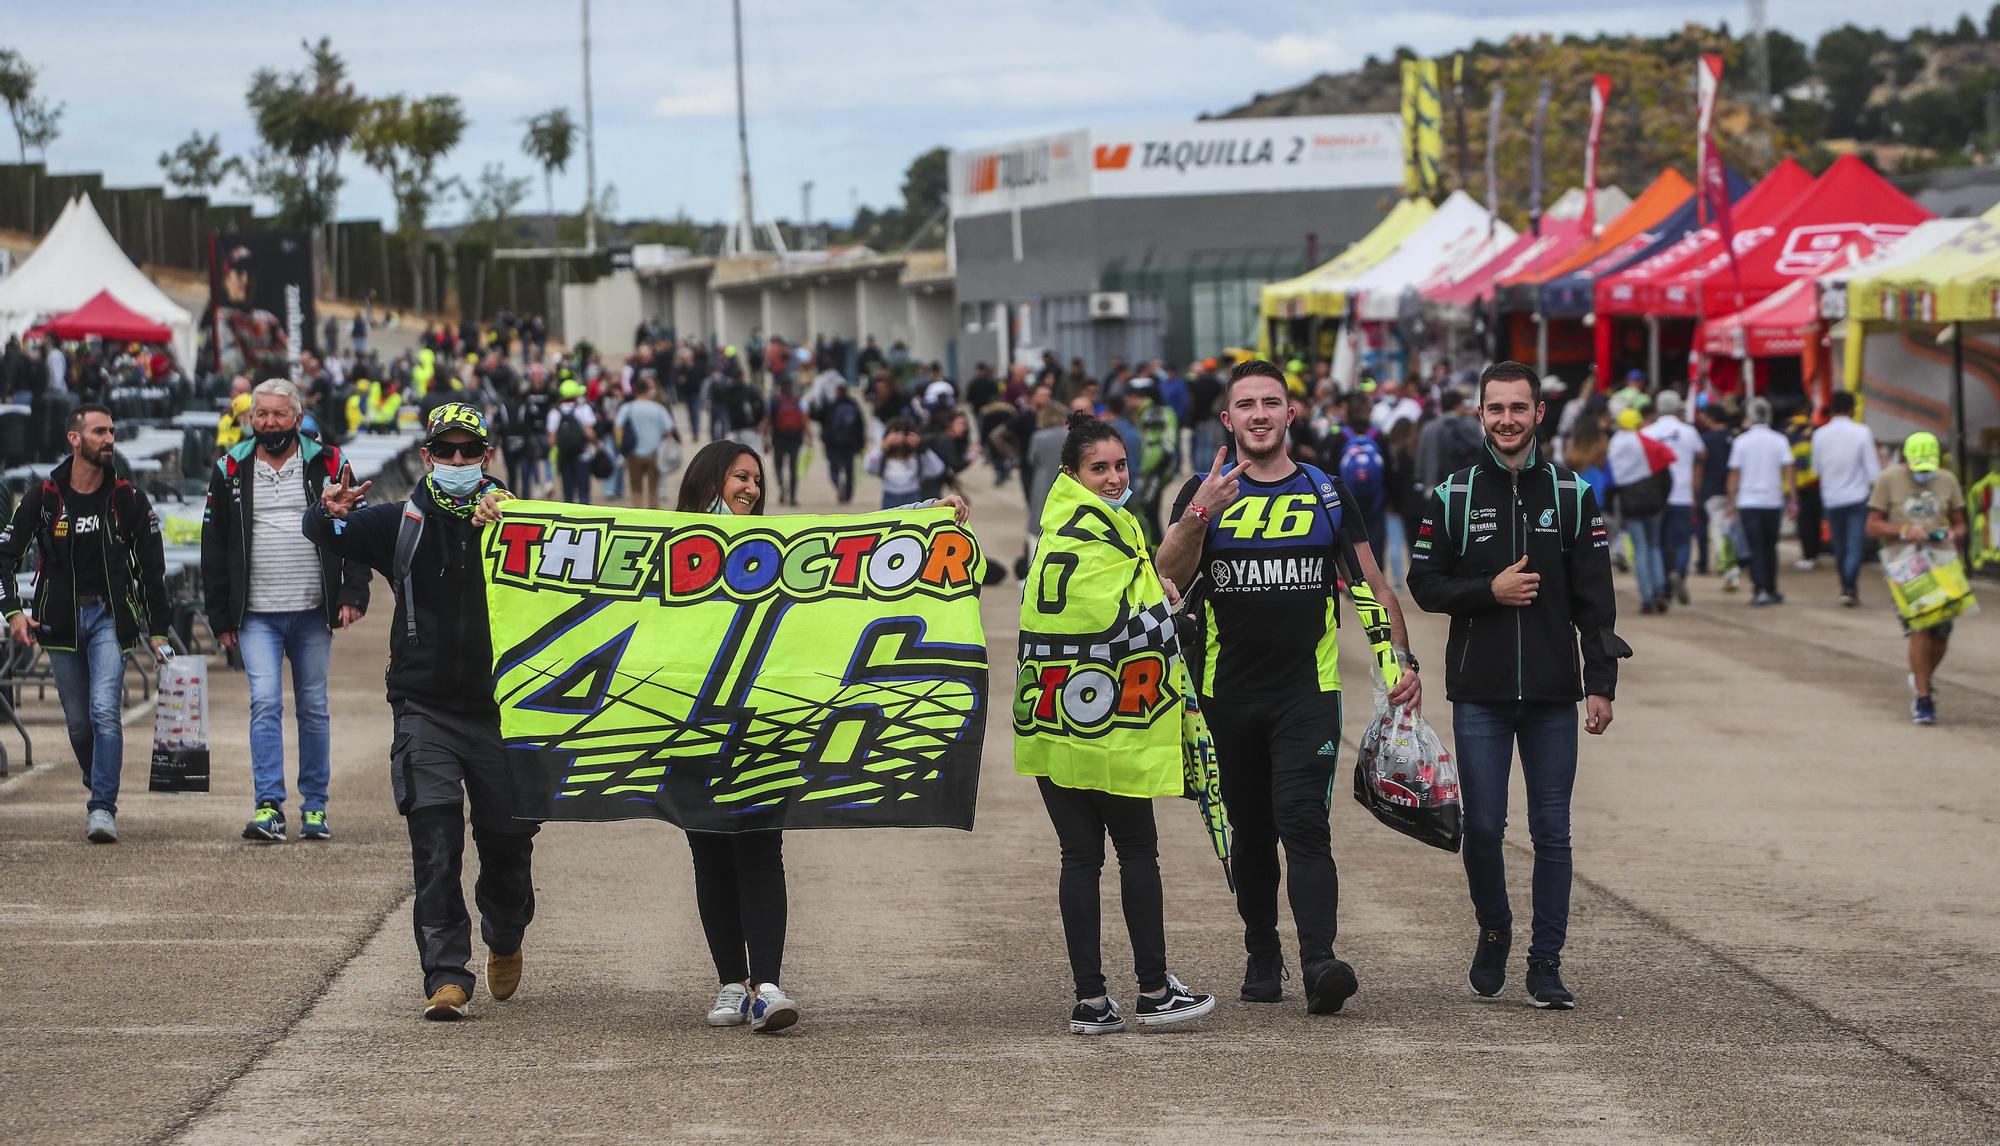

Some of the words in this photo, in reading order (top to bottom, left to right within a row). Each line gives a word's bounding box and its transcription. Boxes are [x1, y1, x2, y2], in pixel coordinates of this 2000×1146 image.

[1141, 137, 1274, 173] TAQUILLA
[1286, 136, 1306, 165] 2
[1218, 493, 1318, 539] 46
[498, 521, 656, 590] THE
[668, 527, 975, 597] DOCTOR
[1231, 557, 1324, 585] YAMAHA
[1214, 585, 1271, 593] FACTORY
[1279, 583, 1323, 591] RACING
[493, 594, 988, 811] 46
[1012, 656, 1164, 724] CTOR
[1395, 738, 1409, 747] 24
